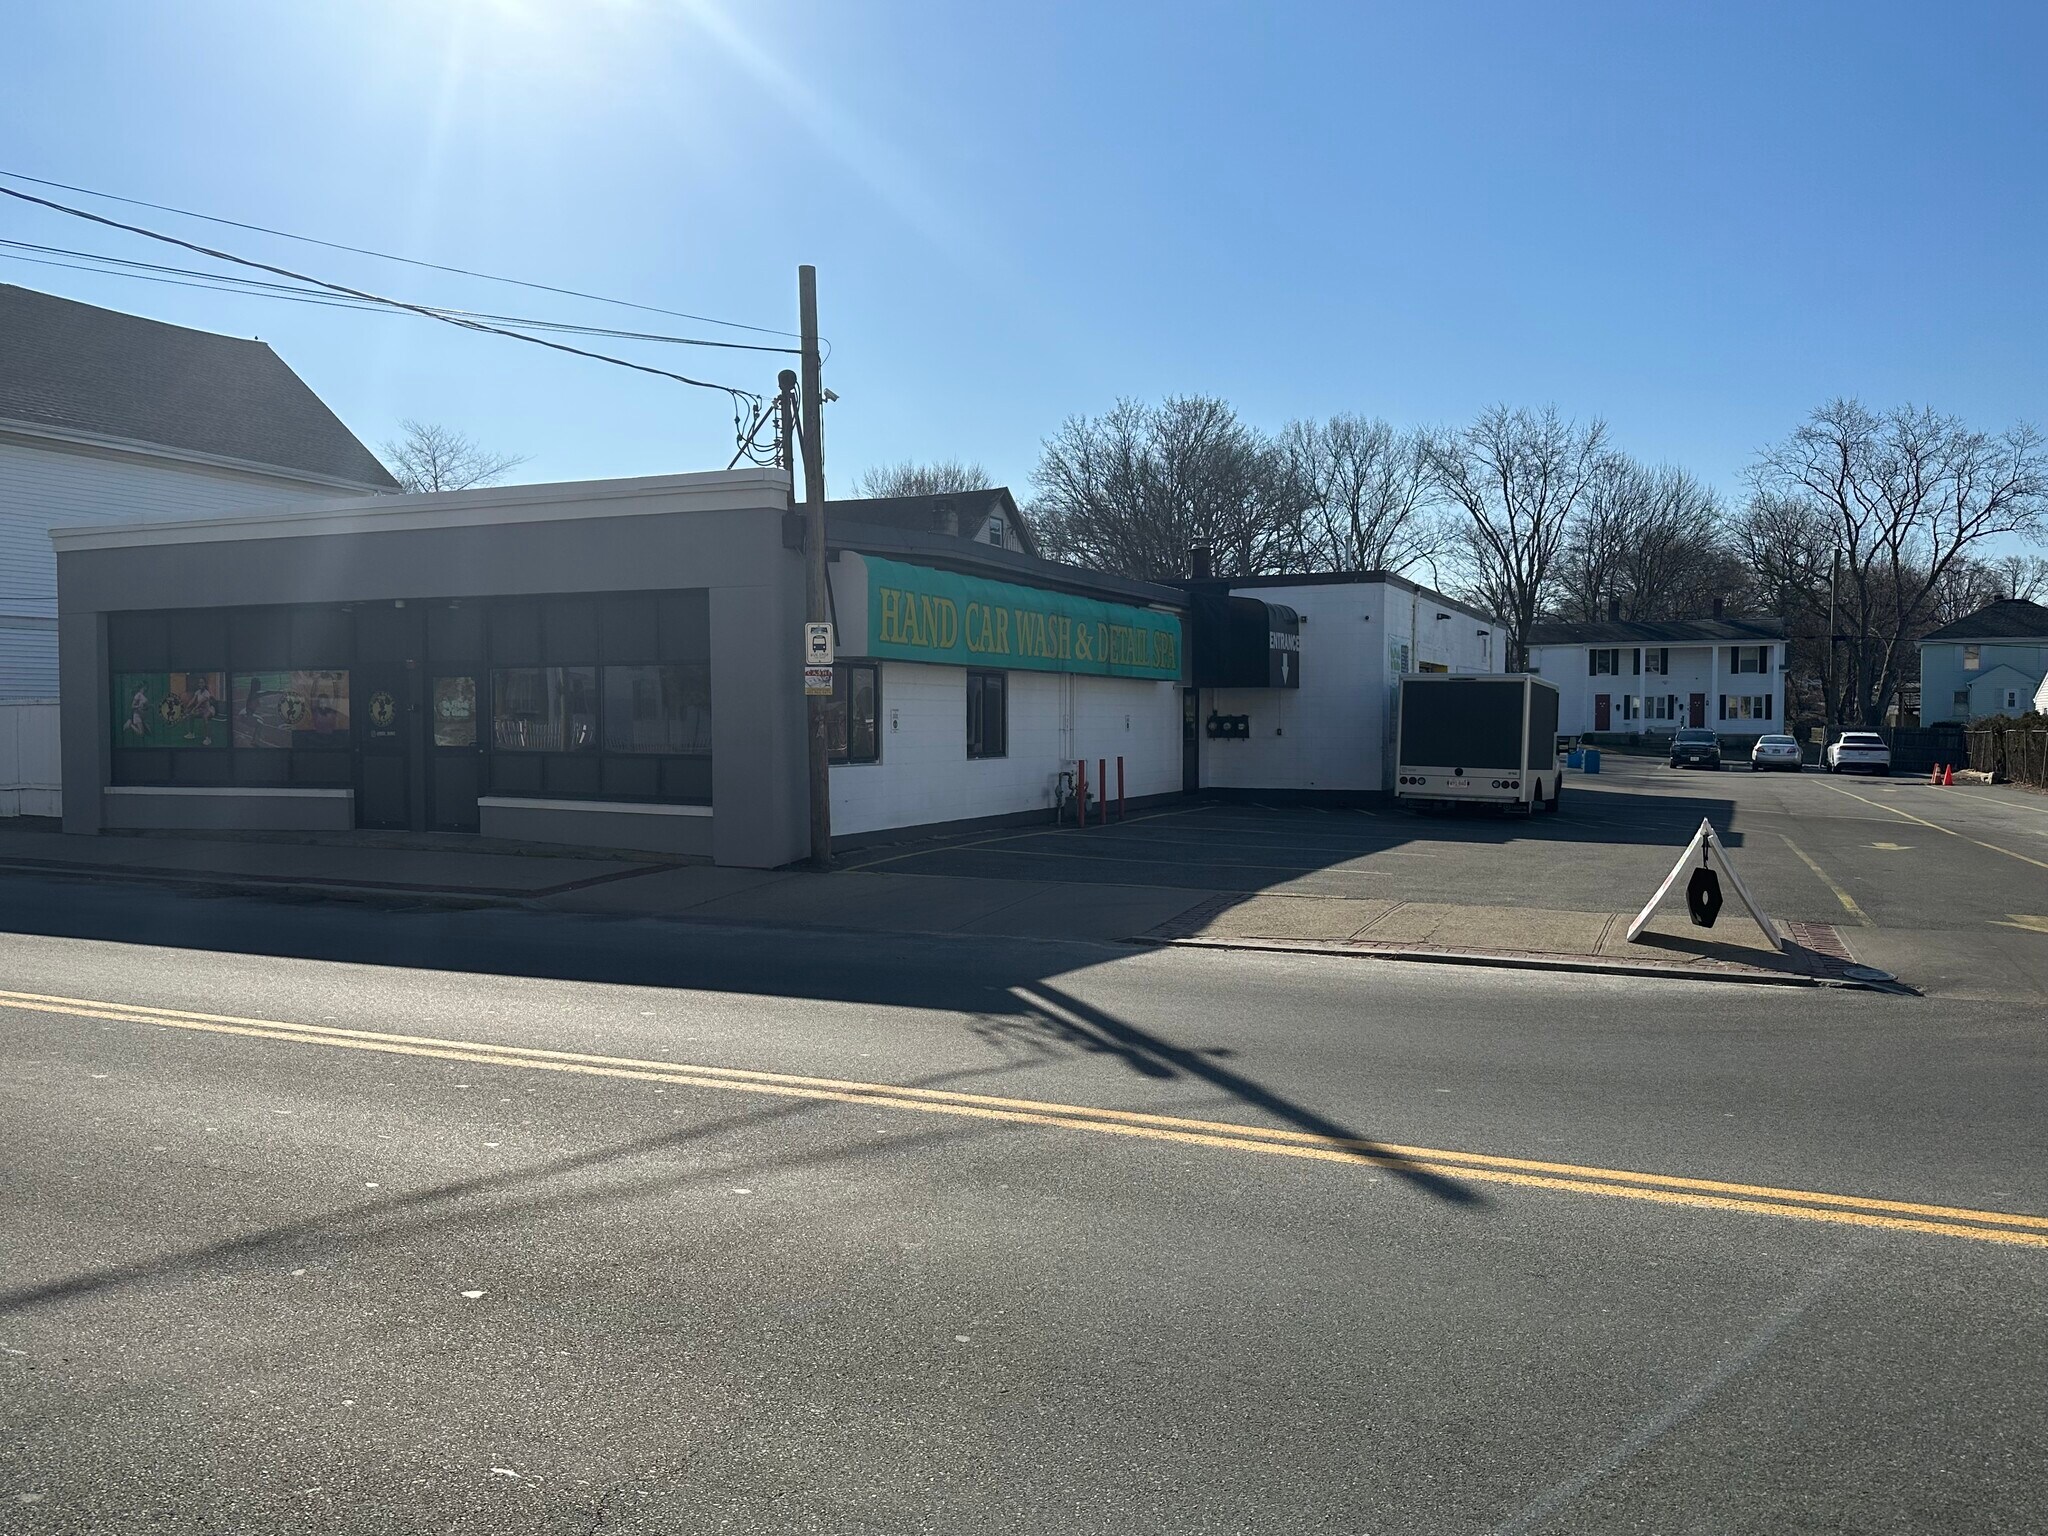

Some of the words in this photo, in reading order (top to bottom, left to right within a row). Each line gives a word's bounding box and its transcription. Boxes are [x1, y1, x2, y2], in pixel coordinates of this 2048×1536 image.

[879, 586, 958, 649] HAND
[965, 601, 1010, 654] CAR
[1014, 608, 1072, 660] WASH
[1075, 622, 1094, 661] &
[1097, 622, 1150, 667] DETAIL
[1152, 629, 1177, 670] SPA
[1269, 631, 1300, 652] ENTRANCE
